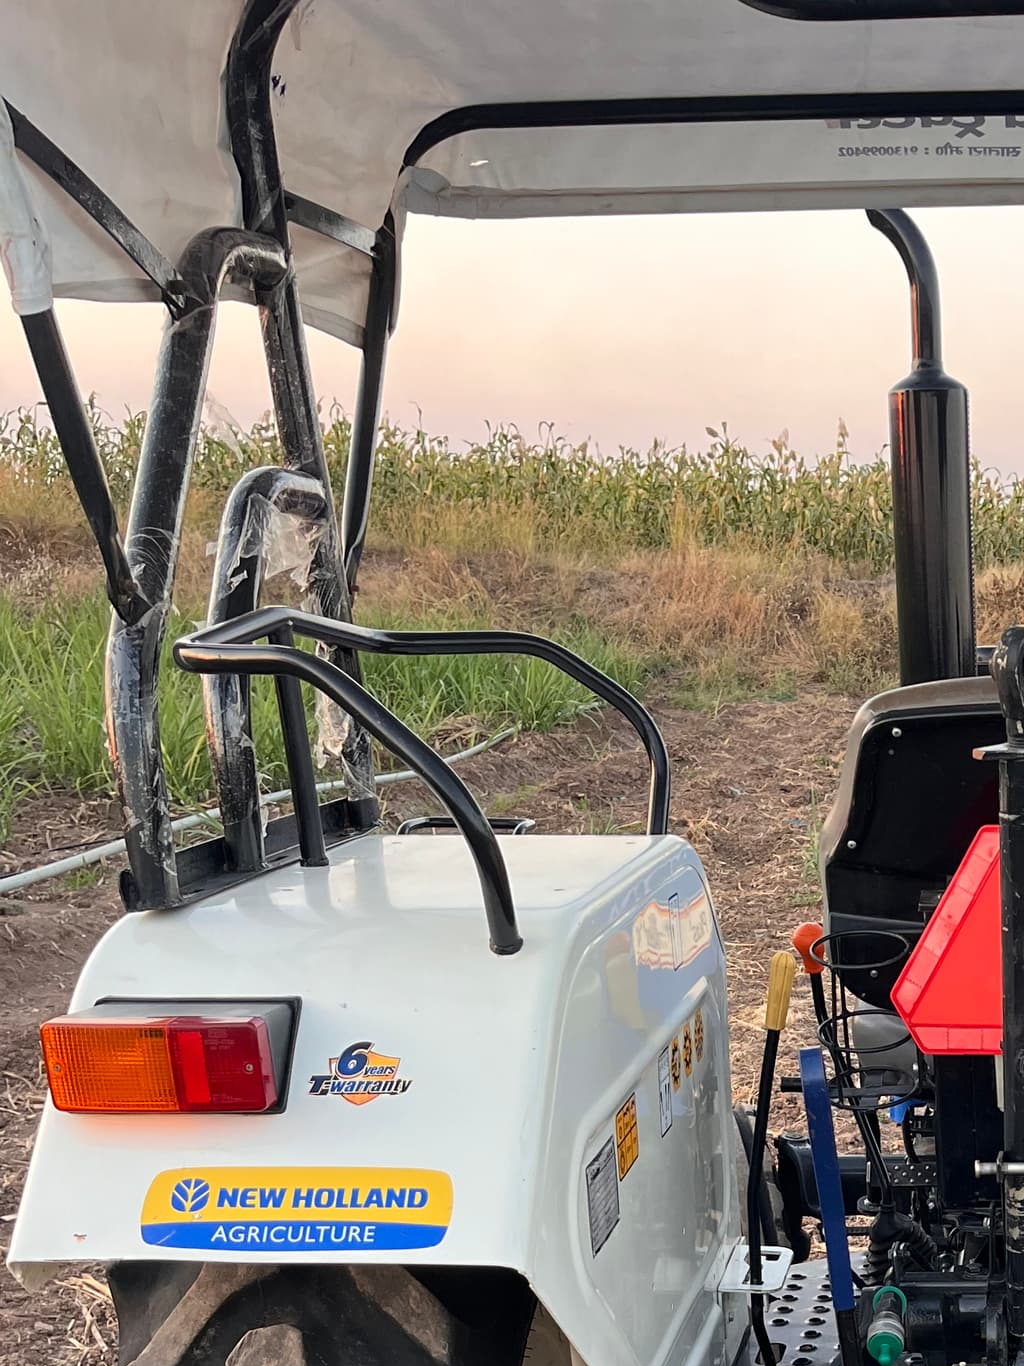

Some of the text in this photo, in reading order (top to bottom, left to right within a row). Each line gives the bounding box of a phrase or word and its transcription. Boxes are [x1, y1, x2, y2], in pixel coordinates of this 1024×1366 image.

[337, 1041, 396, 1077] 6 years
[216, 1187, 428, 1209] NEW HOLLAND
[210, 1225, 377, 1243] AGRICULTURE
